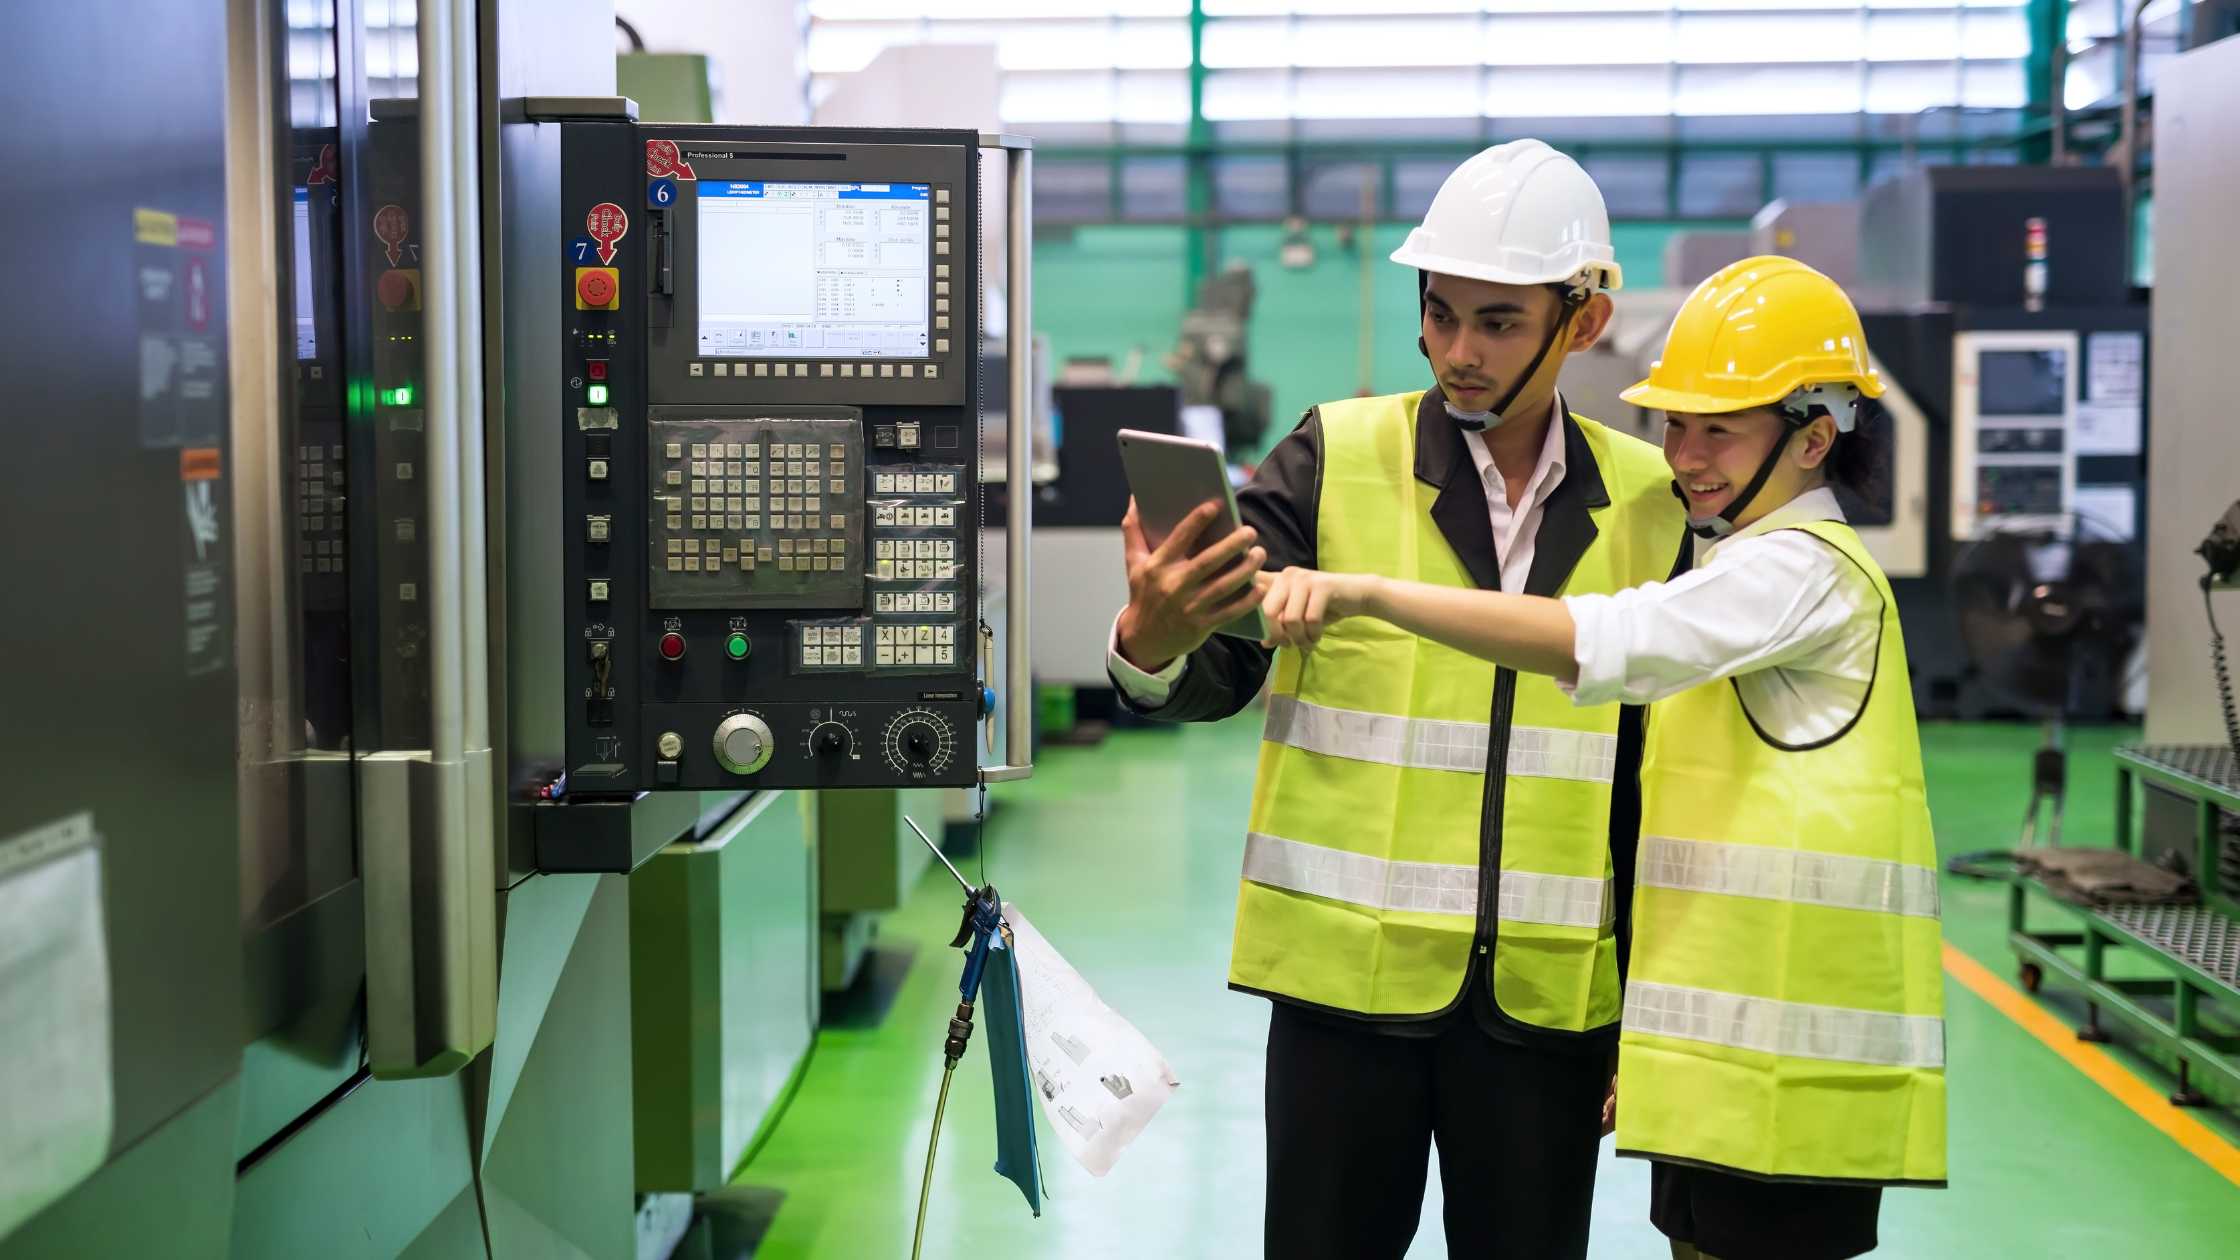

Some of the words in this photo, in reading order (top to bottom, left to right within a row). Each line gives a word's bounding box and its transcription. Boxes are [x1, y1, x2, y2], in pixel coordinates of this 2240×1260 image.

[687, 151, 728, 159] Professional
[657, 184, 669, 203] 6
[576, 243, 587, 261] 7
[881, 630, 889, 641] X
[901, 630, 909, 641] Y
[920, 630, 928, 641] Z
[940, 630, 947, 641] 4
[941, 651, 948, 660] 5
